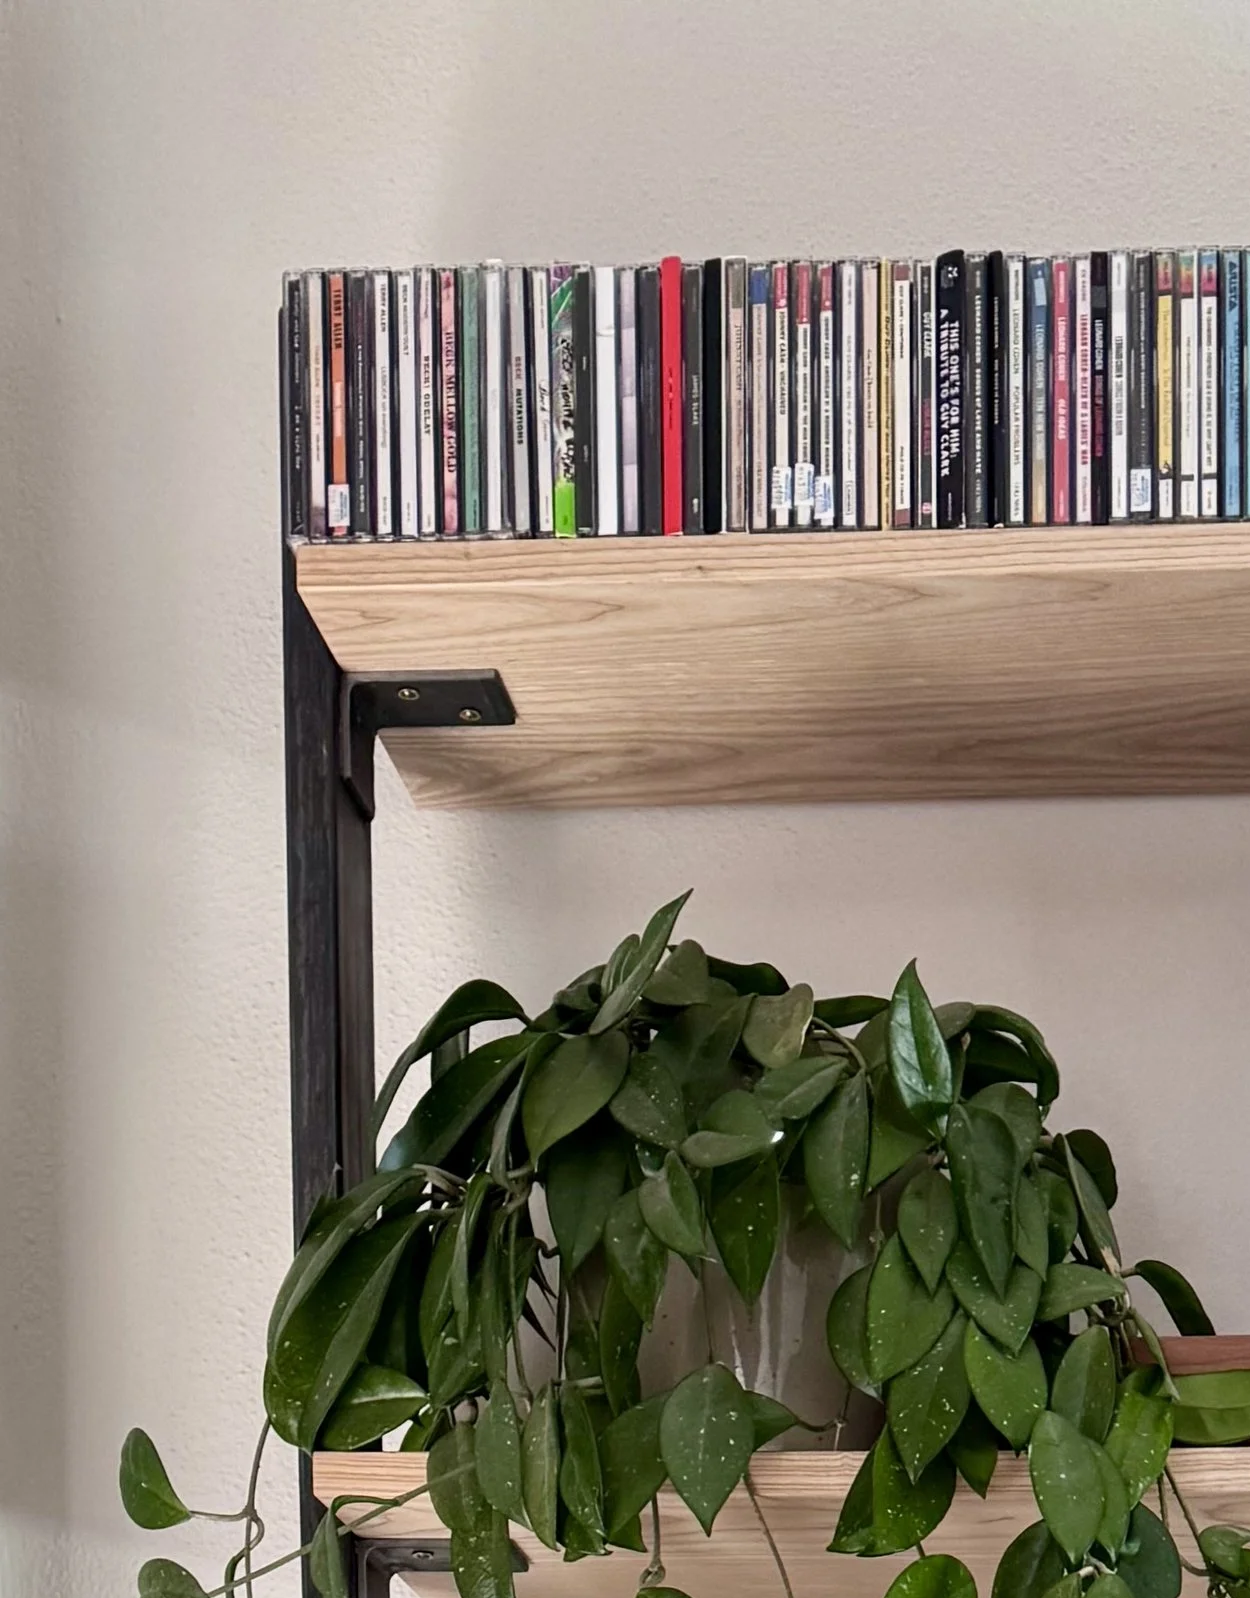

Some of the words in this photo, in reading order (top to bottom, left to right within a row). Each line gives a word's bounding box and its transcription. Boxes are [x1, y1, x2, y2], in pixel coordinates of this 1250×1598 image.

[1228, 261, 1238, 312] ARISTA
[940, 309, 948, 318] A
[939, 321, 949, 375] TRIBUTE
[950, 321, 959, 352] THIS
[940, 380, 949, 398] TO
[950, 356, 959, 395] ONE'S
[445, 374, 456, 433] MELLOW
[516, 389, 524, 445] MUTATIONS
[940, 403, 949, 430] GUY
[950, 399, 959, 425] FOR
[446, 436, 457, 473] GOLD
[940, 435, 949, 477] CLARK
